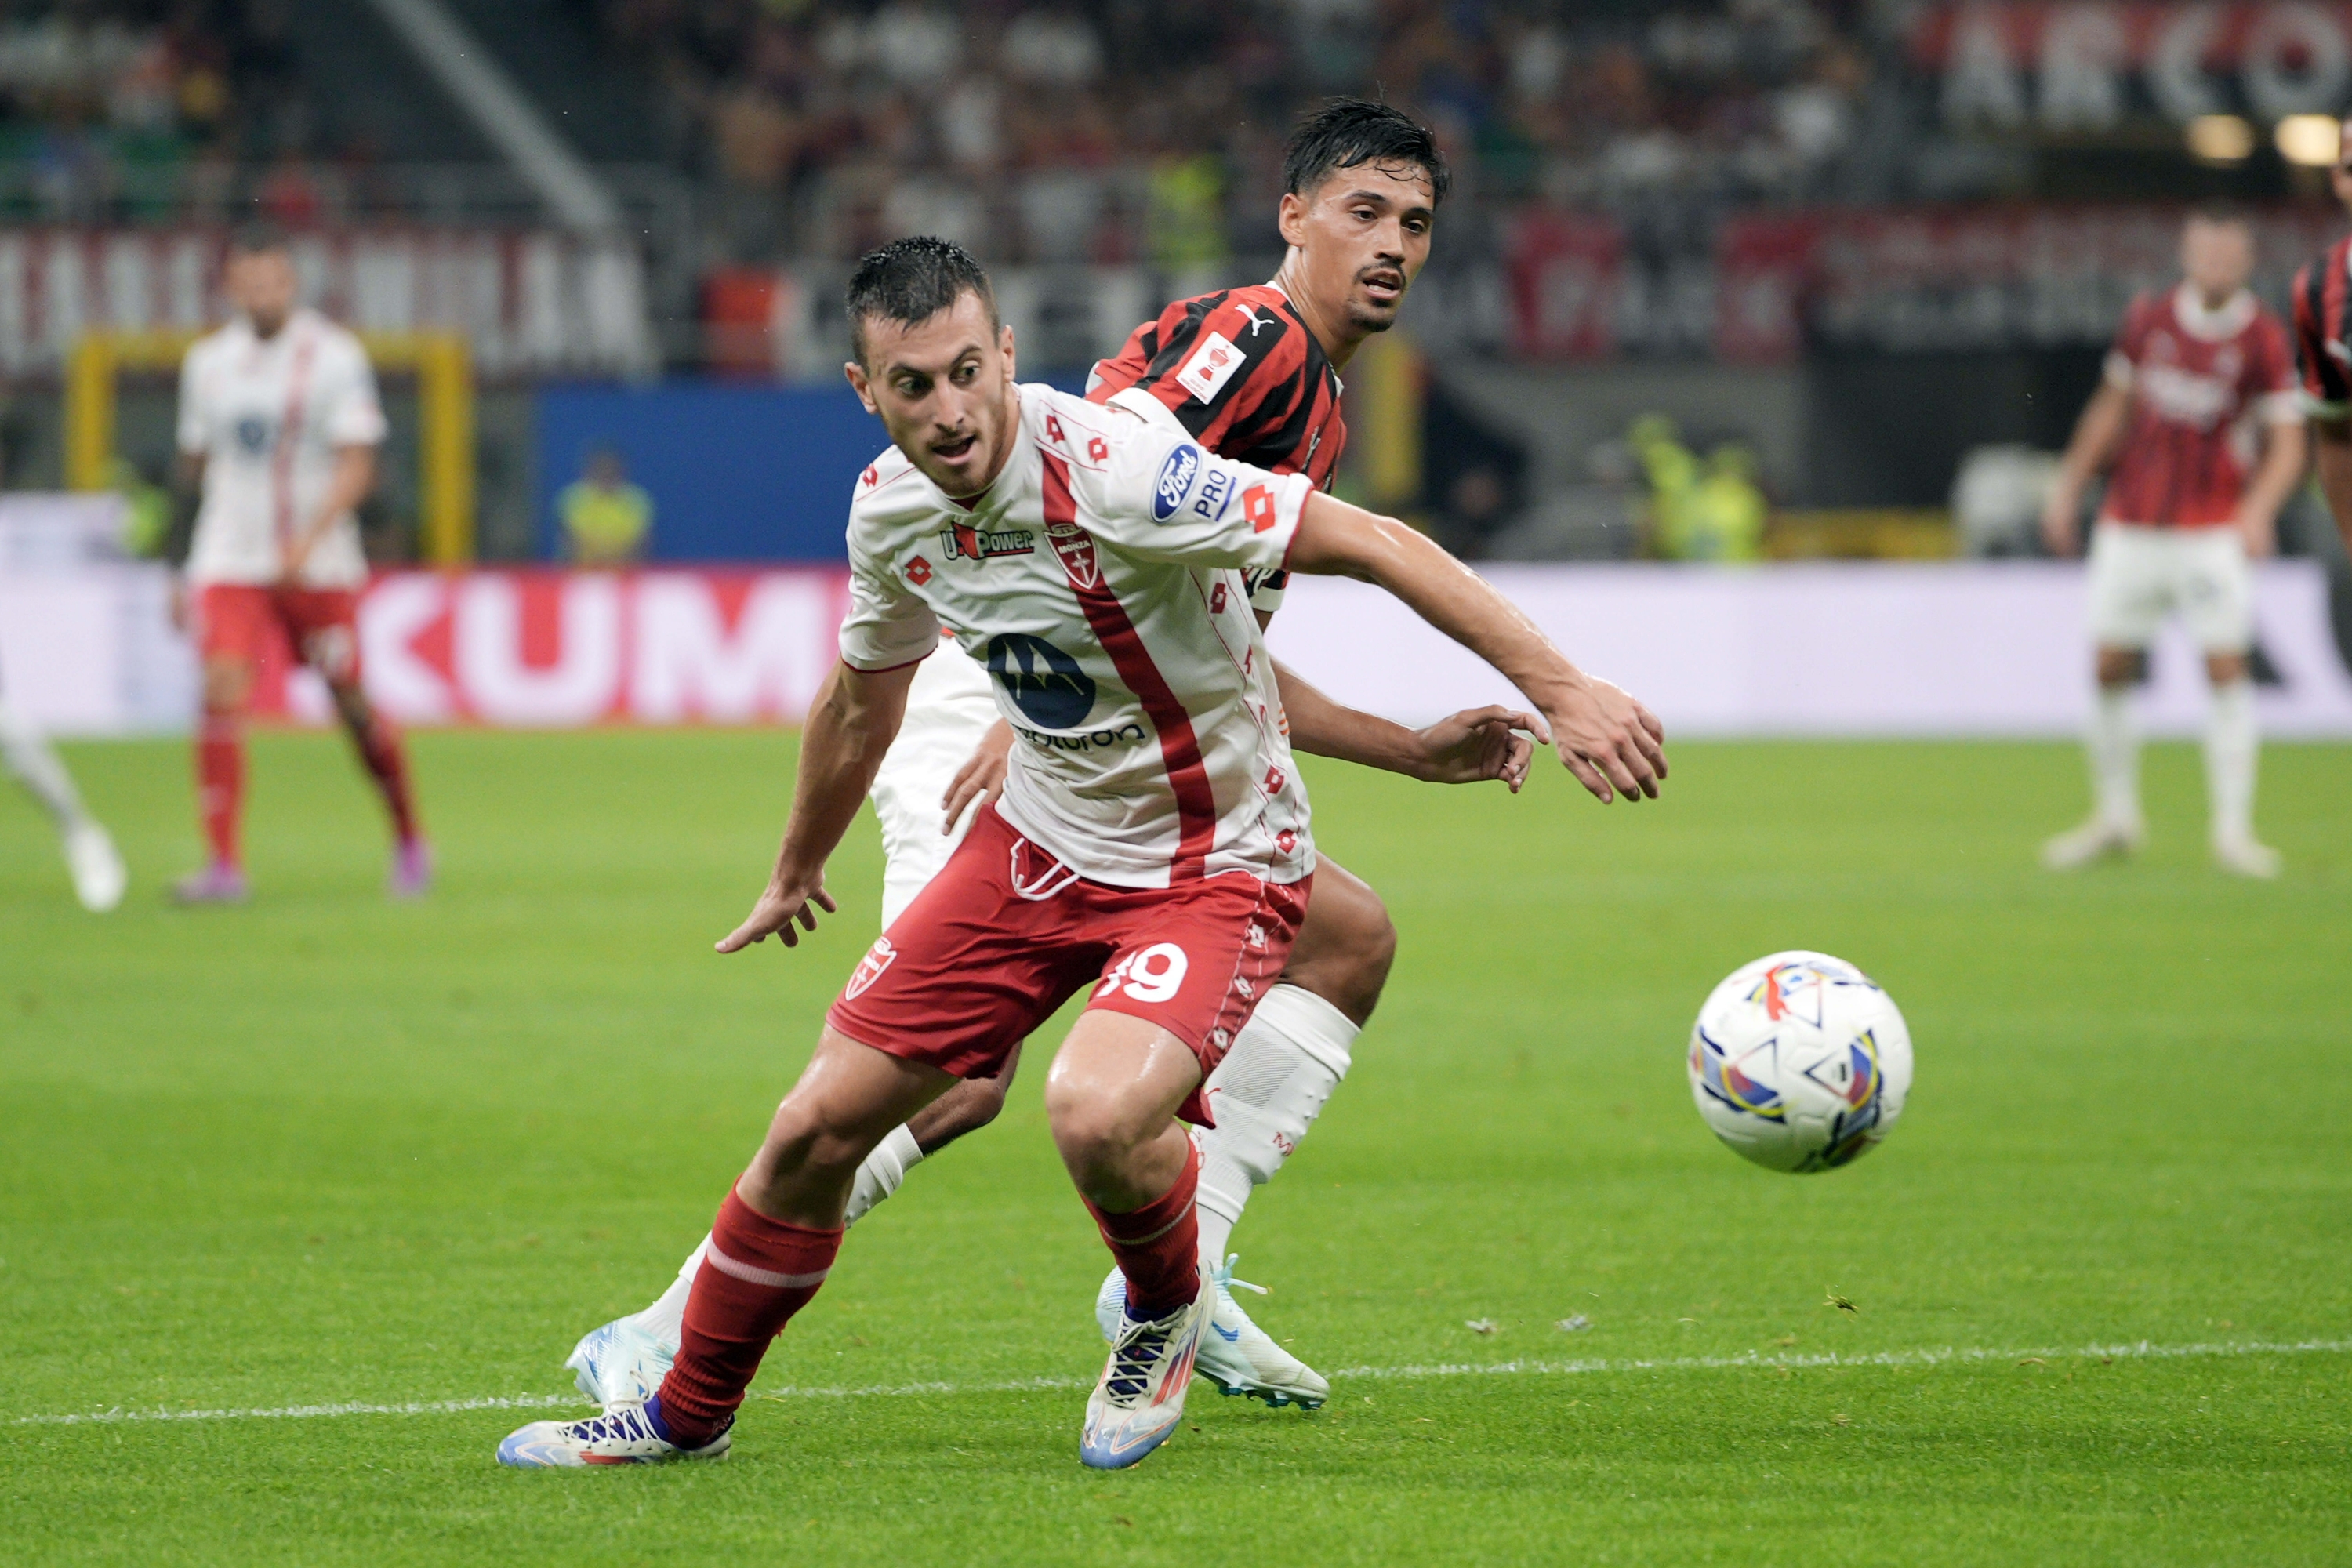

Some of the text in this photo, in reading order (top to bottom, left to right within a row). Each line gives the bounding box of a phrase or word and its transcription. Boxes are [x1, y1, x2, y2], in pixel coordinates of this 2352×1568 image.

[1158, 449, 1197, 507] Ford
[1194, 470, 1227, 518] PRO
[1058, 539, 1091, 554] MONZA
